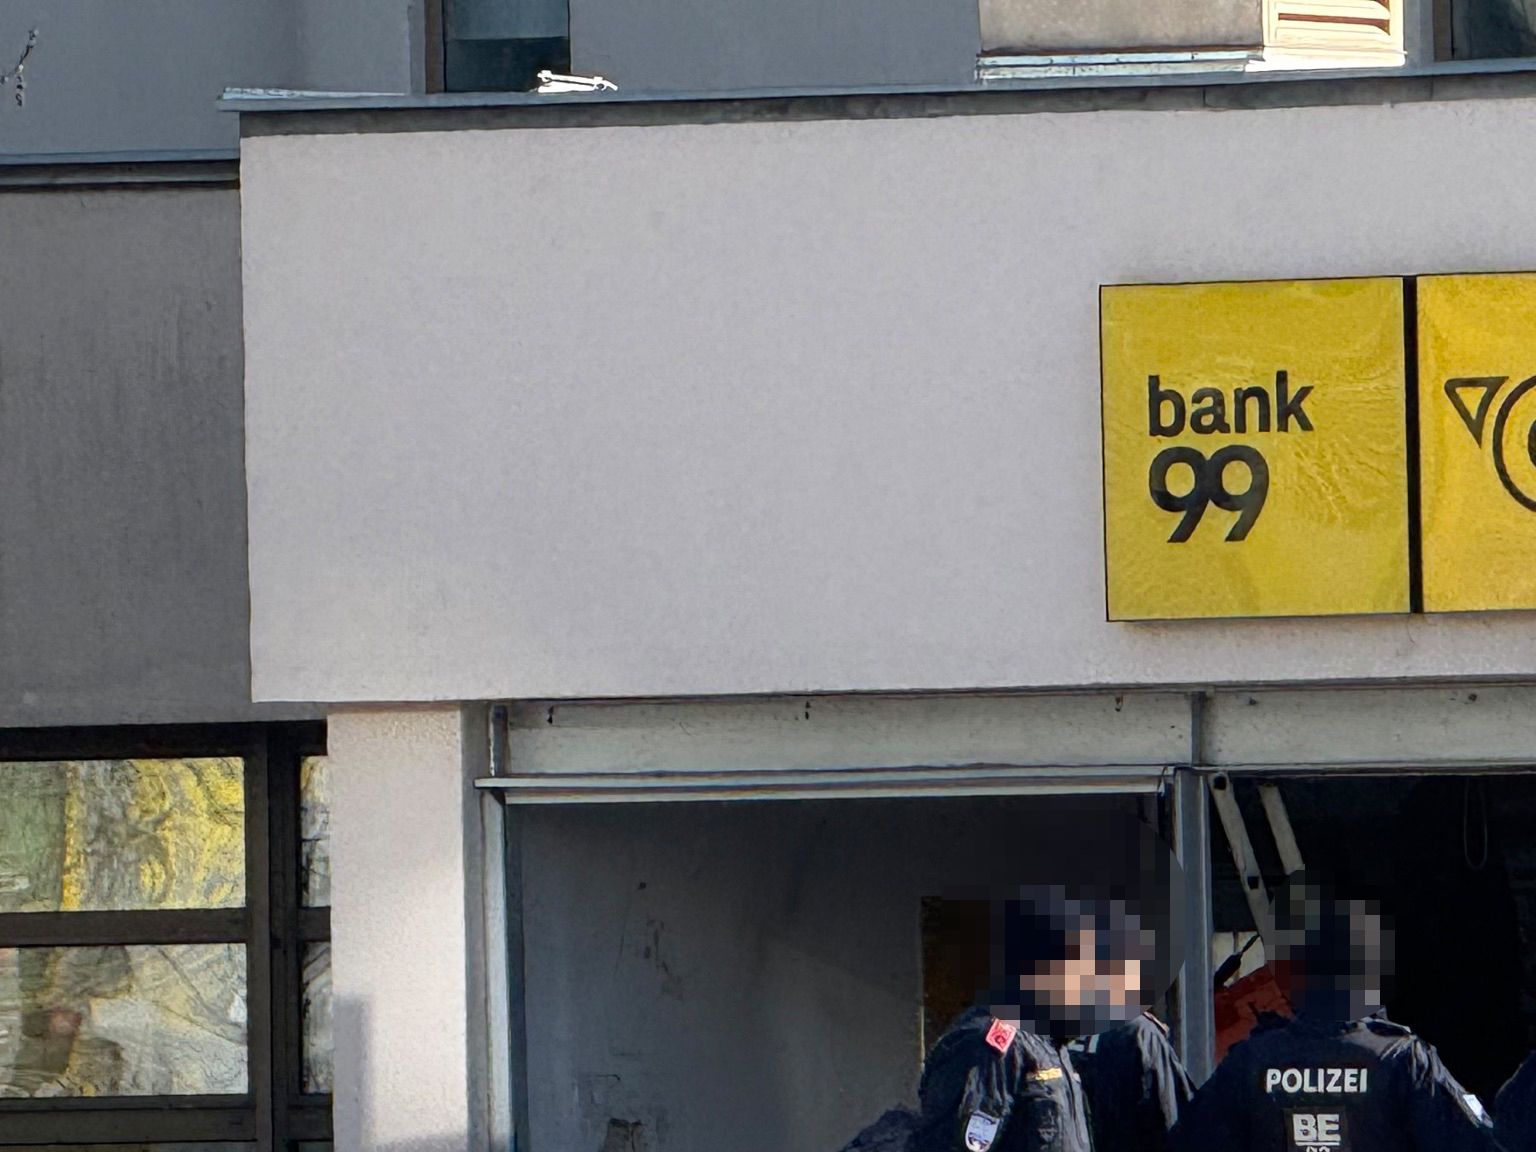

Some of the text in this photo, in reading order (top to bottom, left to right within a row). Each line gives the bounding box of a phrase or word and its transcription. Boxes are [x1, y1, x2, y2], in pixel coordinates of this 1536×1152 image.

[1148, 370, 1314, 437] bank
[1148, 444, 1270, 543] 99
[1266, 1068, 1368, 1093] POLIZEI
[1292, 1113, 1341, 1142] BE
